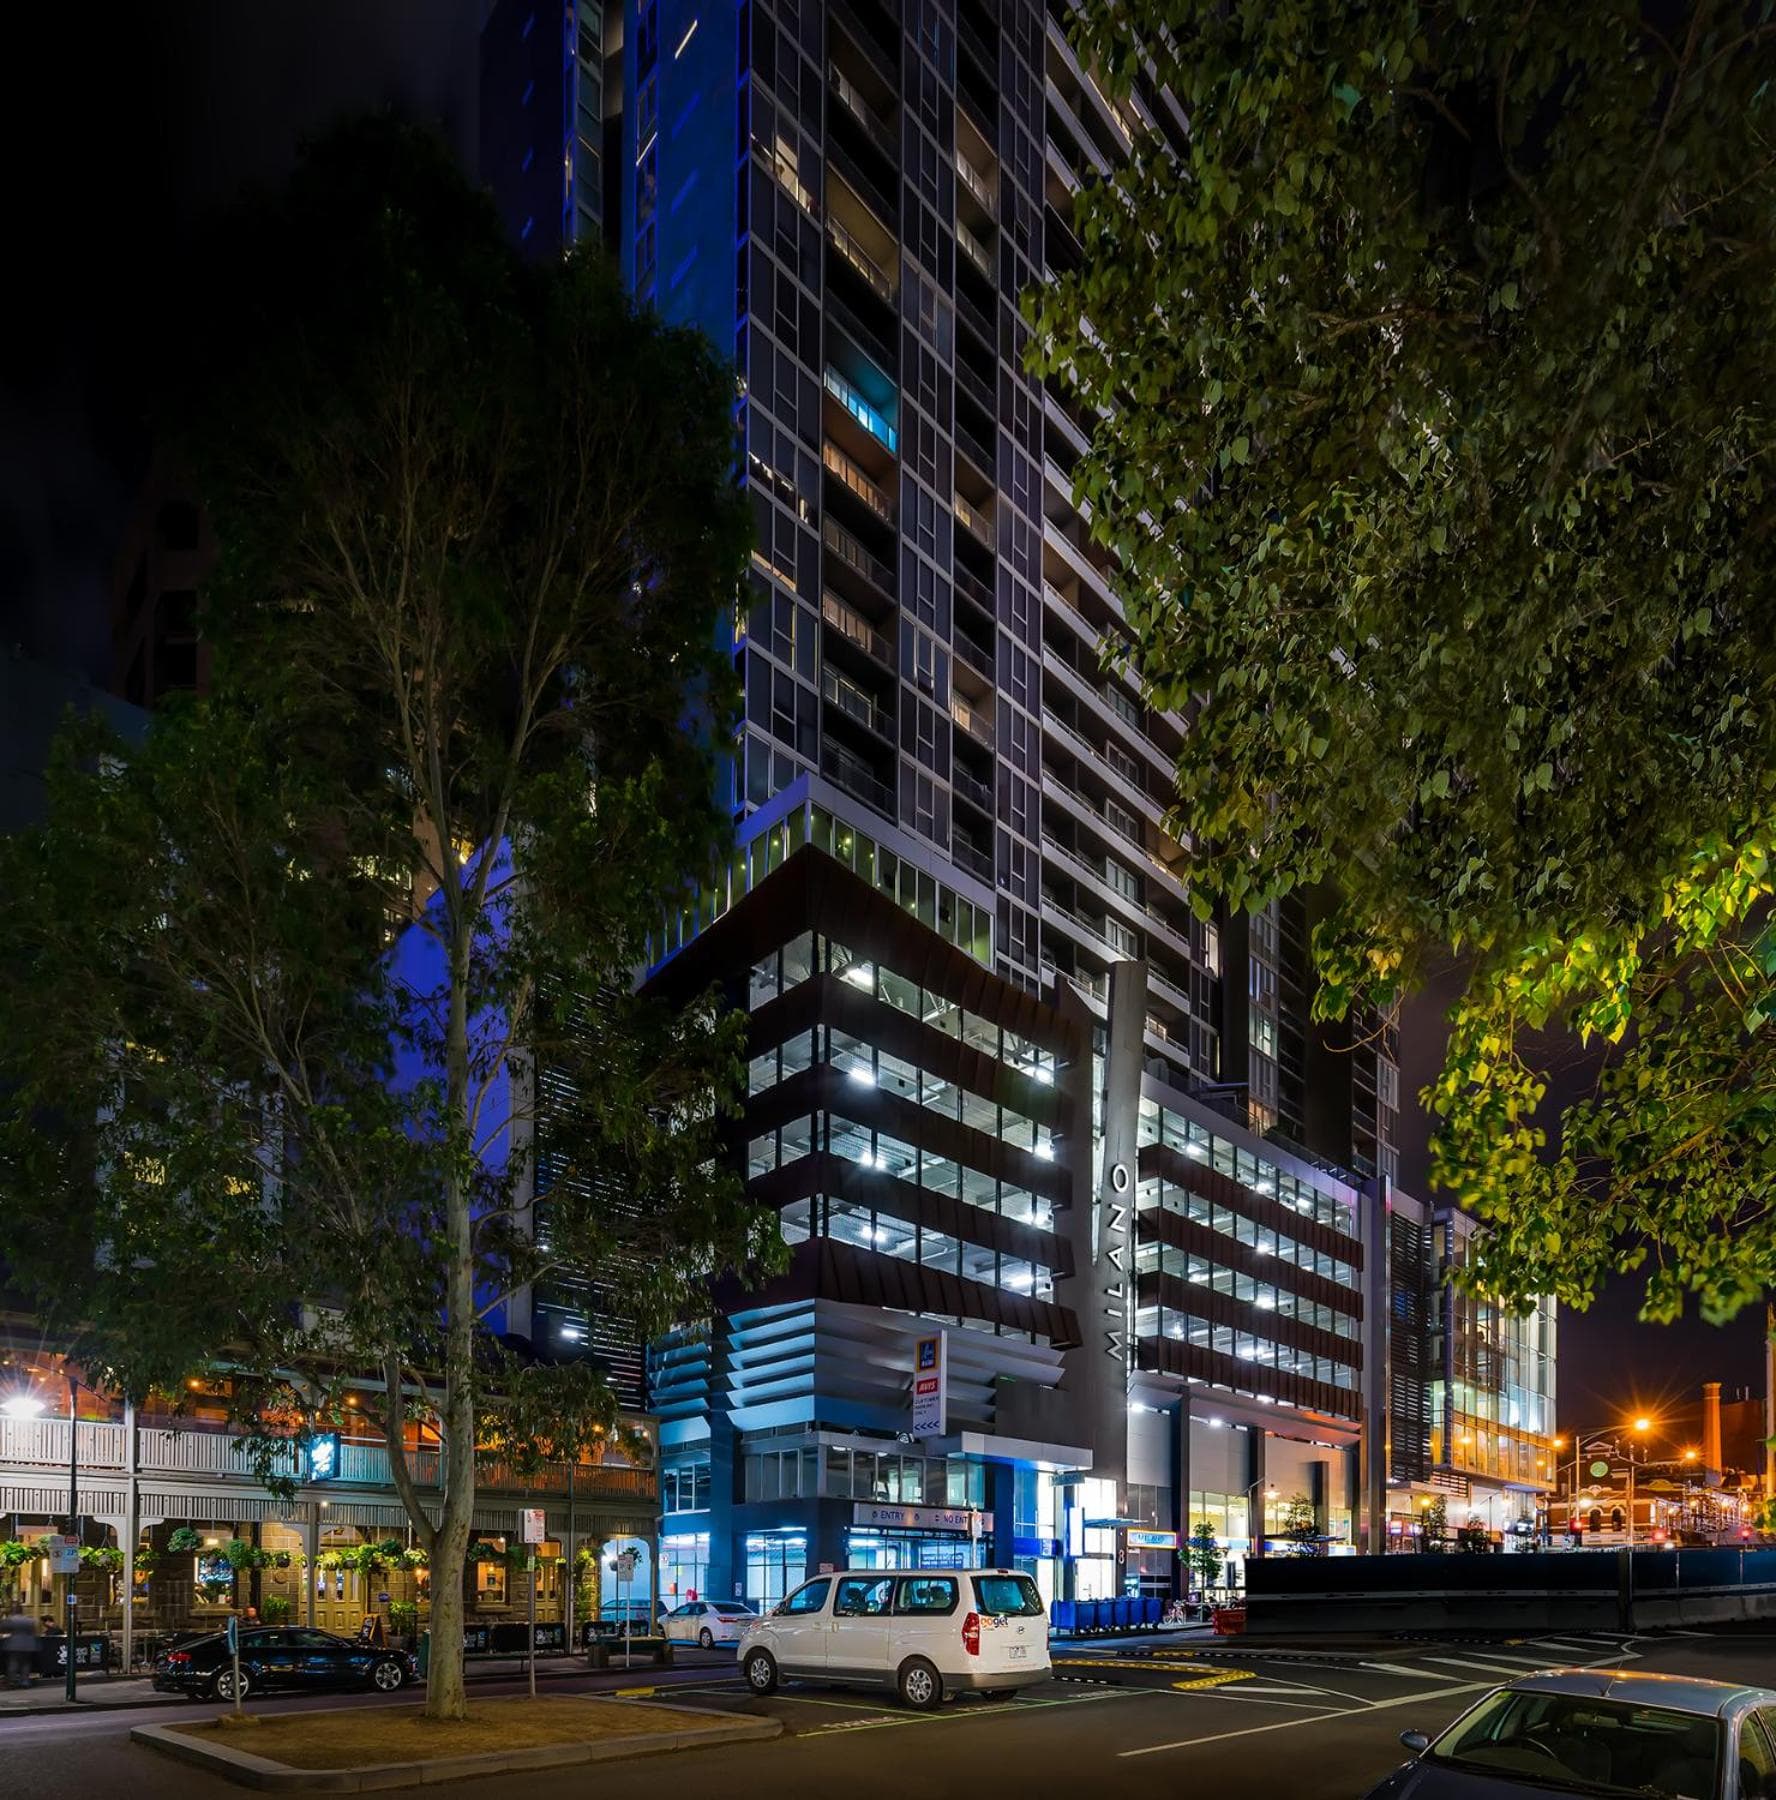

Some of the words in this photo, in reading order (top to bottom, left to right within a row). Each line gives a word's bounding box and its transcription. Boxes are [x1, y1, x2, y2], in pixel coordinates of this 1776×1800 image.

[1105, 1163, 1130, 1361] MILANO
[918, 1380, 936, 1392] AVIS
[880, 1510, 905, 1520] ENTRY
[943, 1513, 953, 1522] NO
